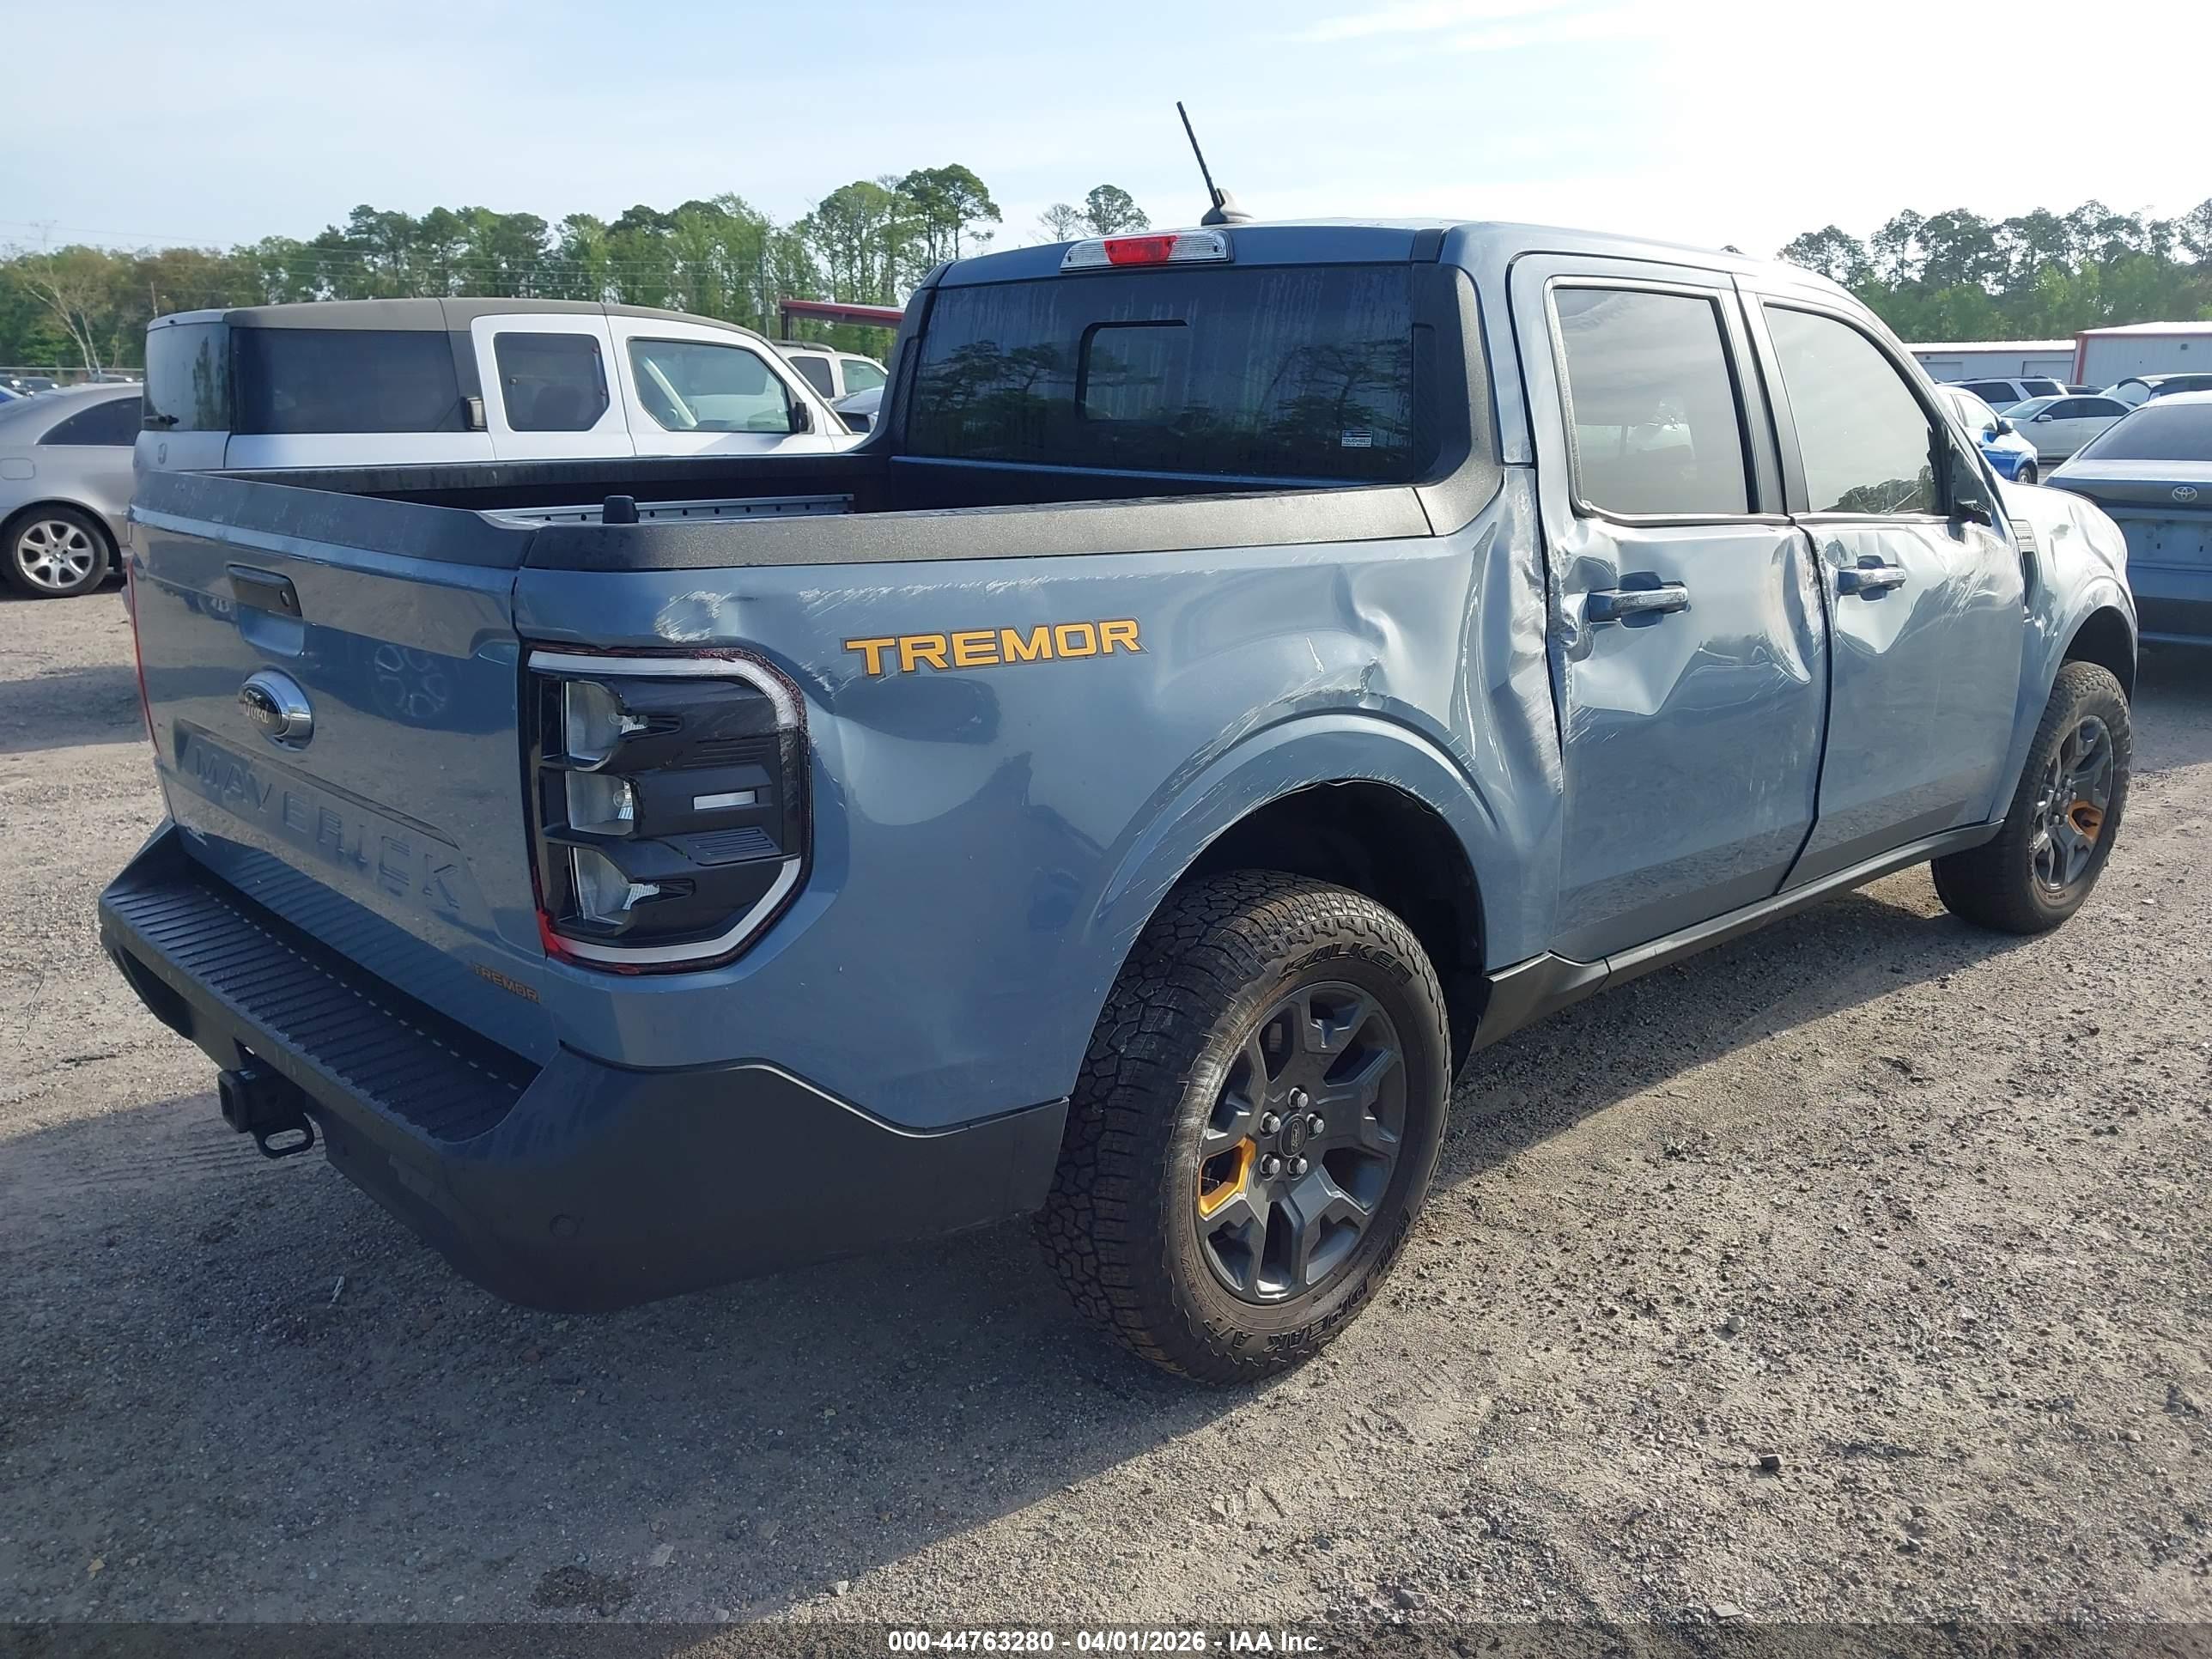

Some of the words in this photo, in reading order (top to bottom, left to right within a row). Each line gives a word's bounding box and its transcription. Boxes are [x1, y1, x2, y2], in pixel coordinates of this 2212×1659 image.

[844, 618, 1144, 678] TREMOR
[242, 690, 270, 724] Ford
[195, 744, 461, 910] MAVERICK
[473, 963, 540, 1005] TREMOR
